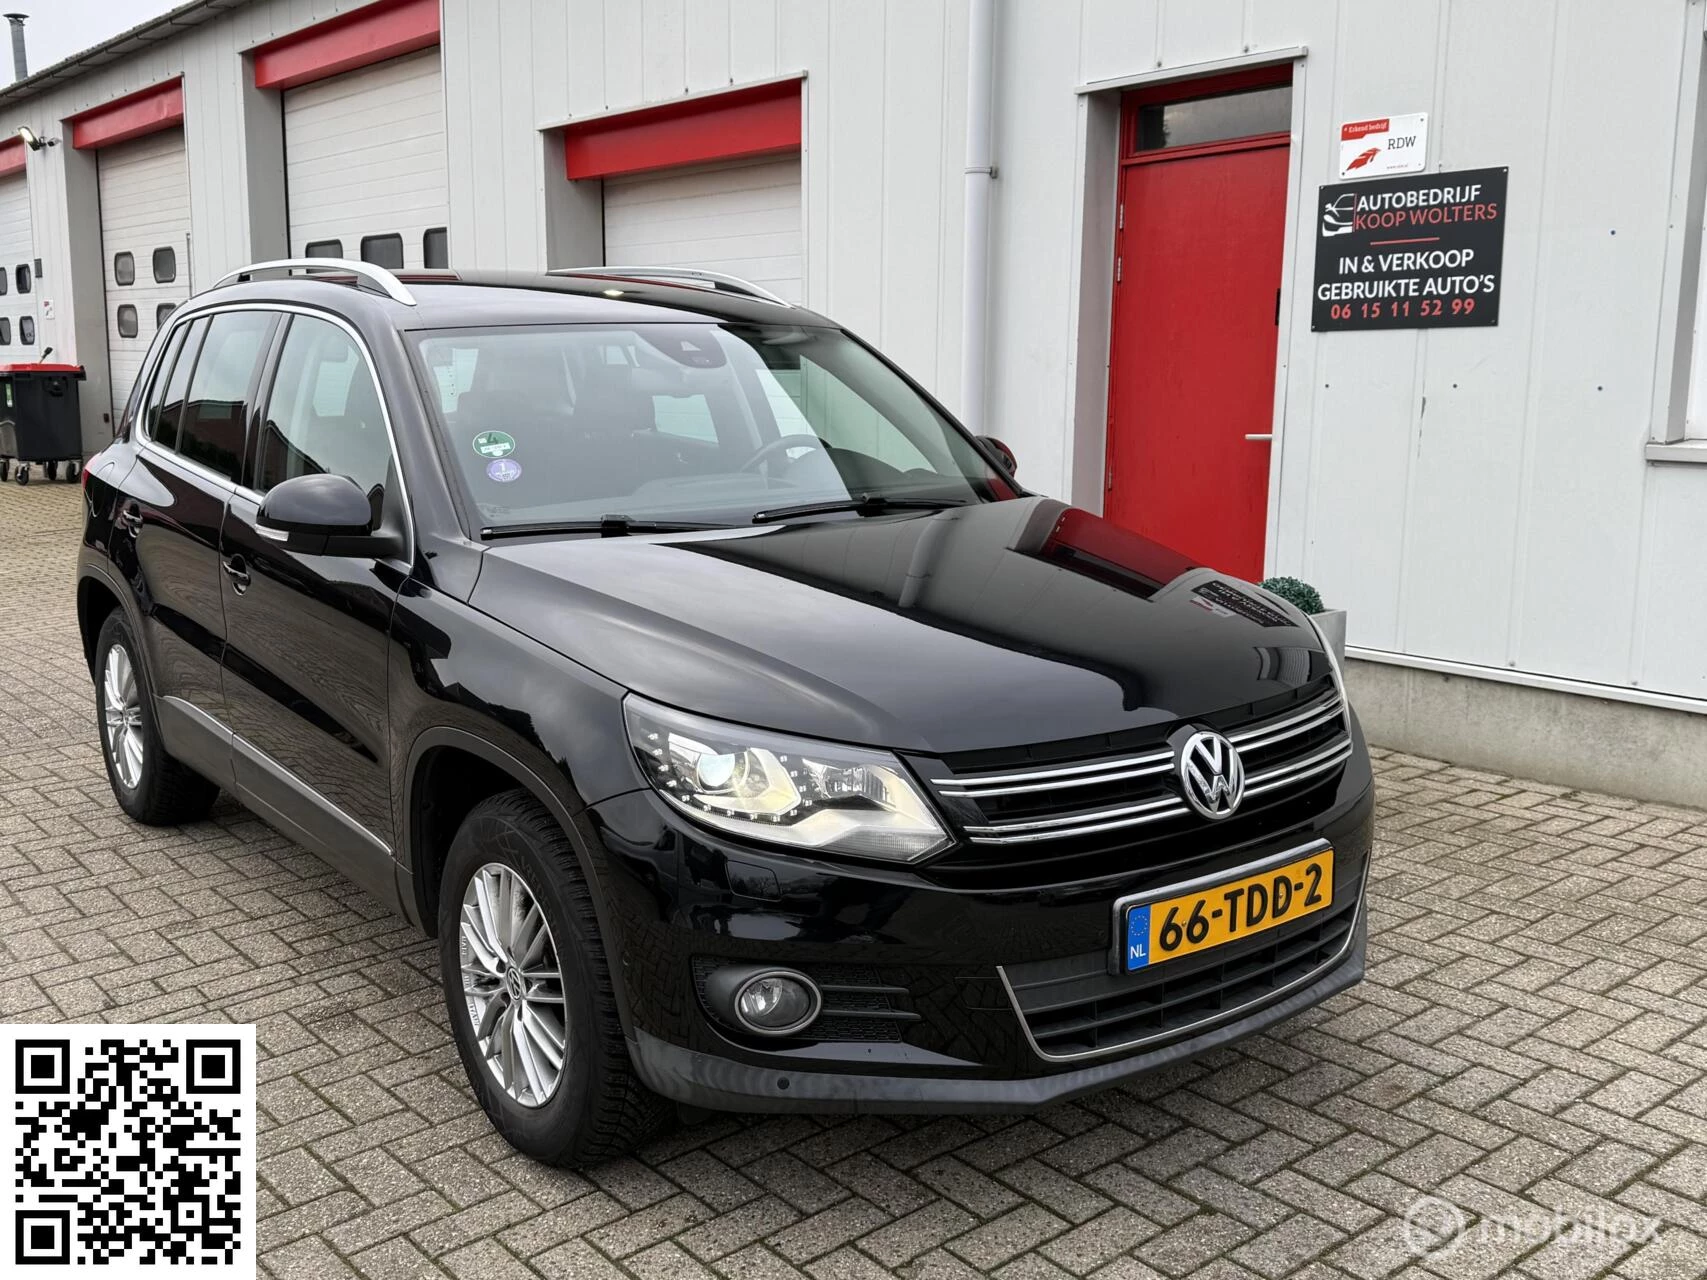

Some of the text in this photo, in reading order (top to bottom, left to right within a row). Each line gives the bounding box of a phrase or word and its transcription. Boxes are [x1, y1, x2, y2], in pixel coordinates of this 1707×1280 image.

[1387, 135, 1417, 150] RDW
[1356, 184, 1482, 212] AUTOBEDRIJF
[1355, 203, 1498, 230] KOOP WOLTERS
[1339, 248, 1475, 275] IN & VERKOOP
[1317, 274, 1496, 301] GEBRUIKTE AUTO'S
[1330, 298, 1476, 320] 06 15 11 52 99
[1158, 862, 1323, 953] 66-TDD-2
[1129, 942, 1147, 960] NL
